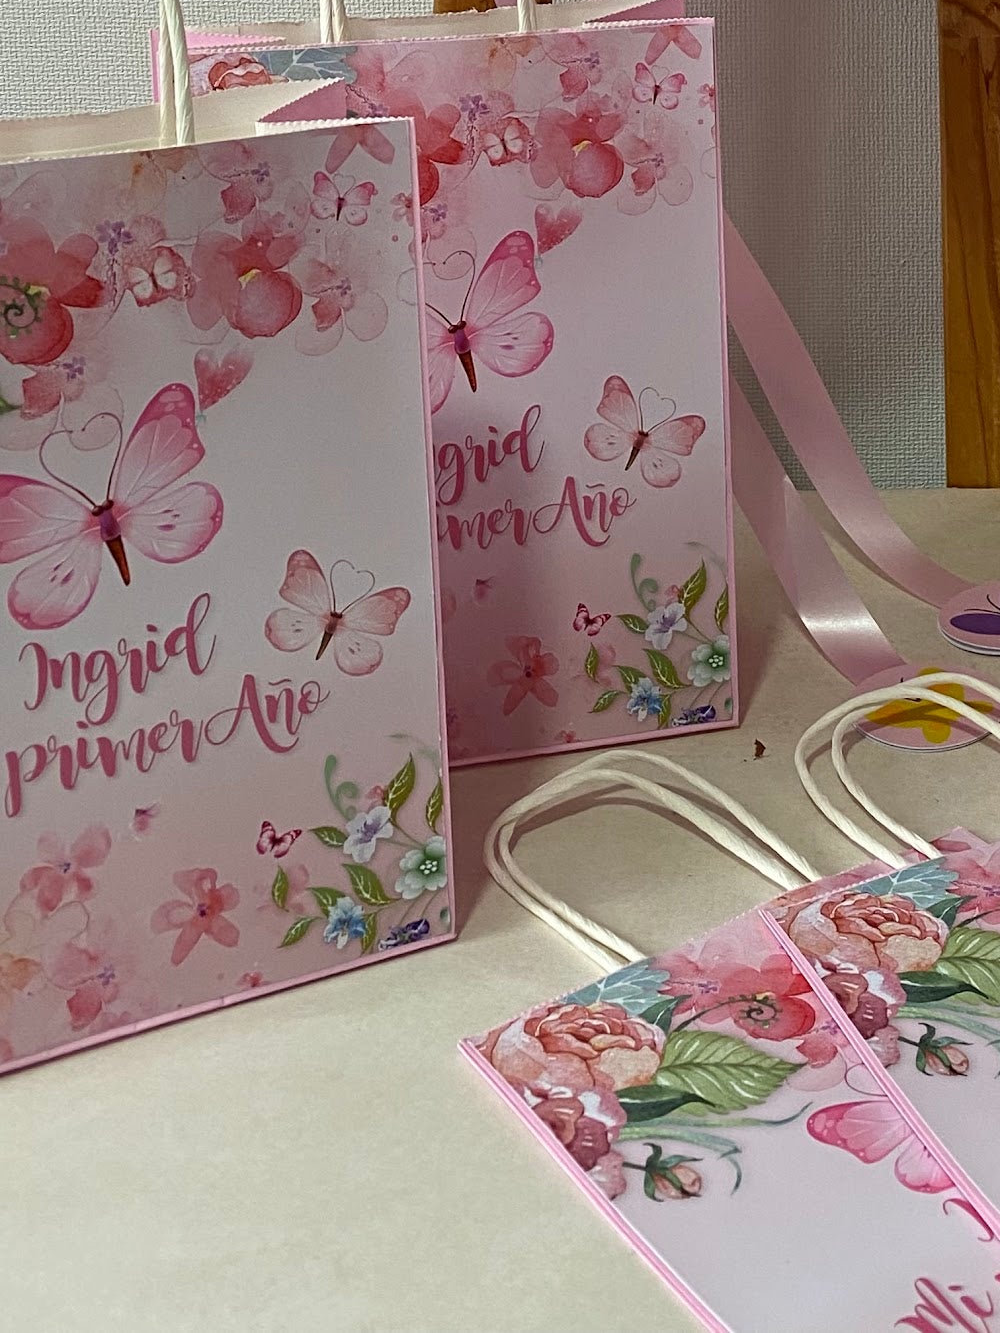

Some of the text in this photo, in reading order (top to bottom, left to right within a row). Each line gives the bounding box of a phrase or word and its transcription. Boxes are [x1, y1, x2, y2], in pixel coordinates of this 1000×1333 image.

[433, 404, 545, 506] grid
[437, 476, 637, 551] mer Año
[19, 592, 216, 726] Ingrid
[4, 673, 330, 818] primer Año
